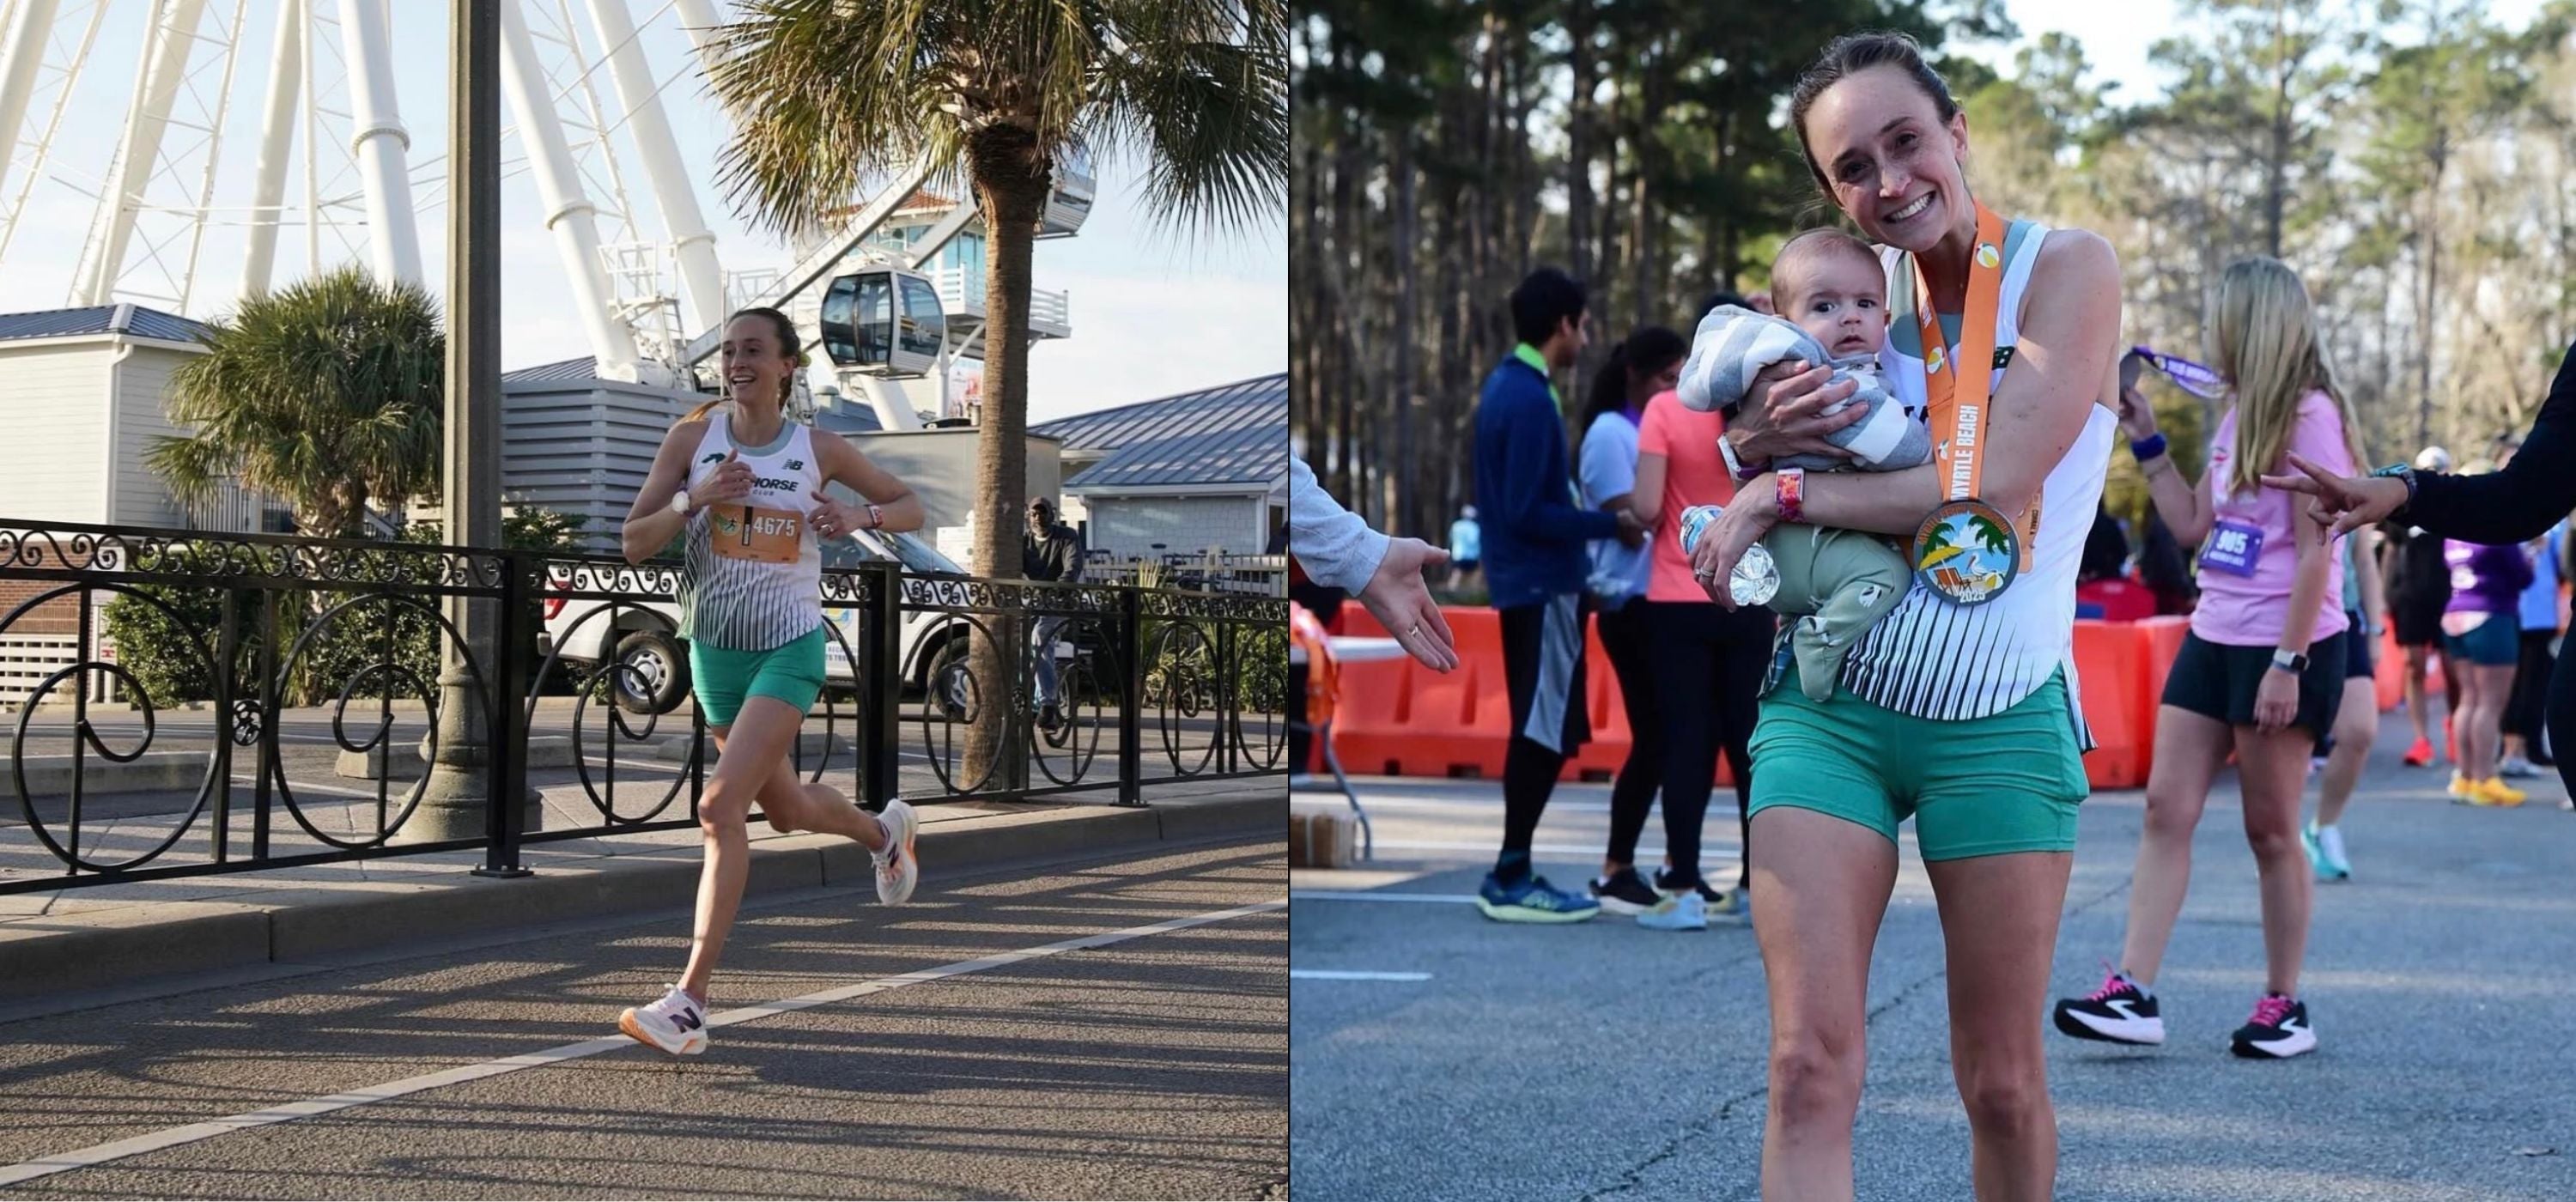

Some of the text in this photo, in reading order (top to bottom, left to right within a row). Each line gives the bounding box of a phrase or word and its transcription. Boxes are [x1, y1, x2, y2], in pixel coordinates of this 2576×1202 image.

[1992, 346, 2014, 370] B
[1956, 404, 1979, 446] BEACH
[781, 458, 804, 471] NB
[1950, 449, 1974, 501] MYRTLE
[753, 516, 796, 537] 4675
[1959, 590, 1986, 604] 2025
